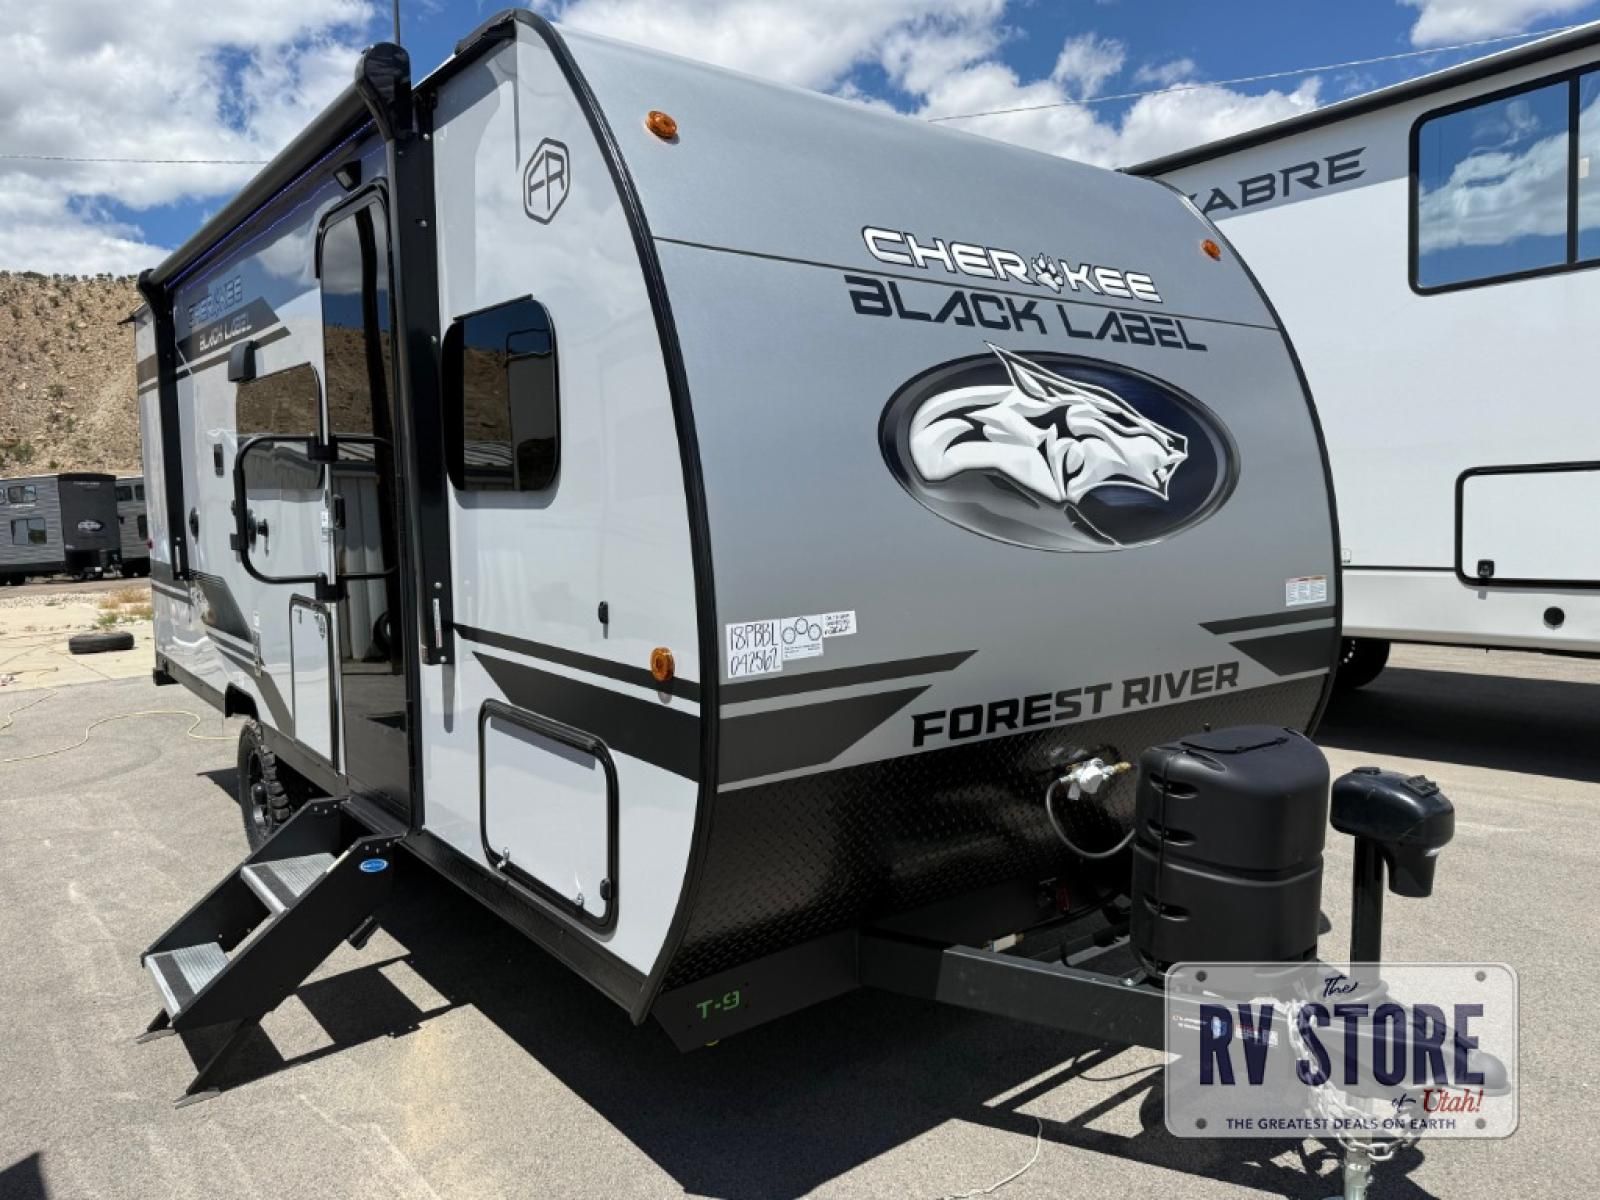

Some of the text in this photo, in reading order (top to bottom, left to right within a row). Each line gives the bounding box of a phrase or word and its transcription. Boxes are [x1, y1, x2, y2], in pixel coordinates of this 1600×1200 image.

[1189, 146, 1367, 215] ABRE
[861, 225, 1163, 303] CHEROKEE
[844, 274, 1208, 352] BLACK LABEL
[911, 661, 1240, 748] FOREST RIVER
[696, 990, 740, 1019] T-9
